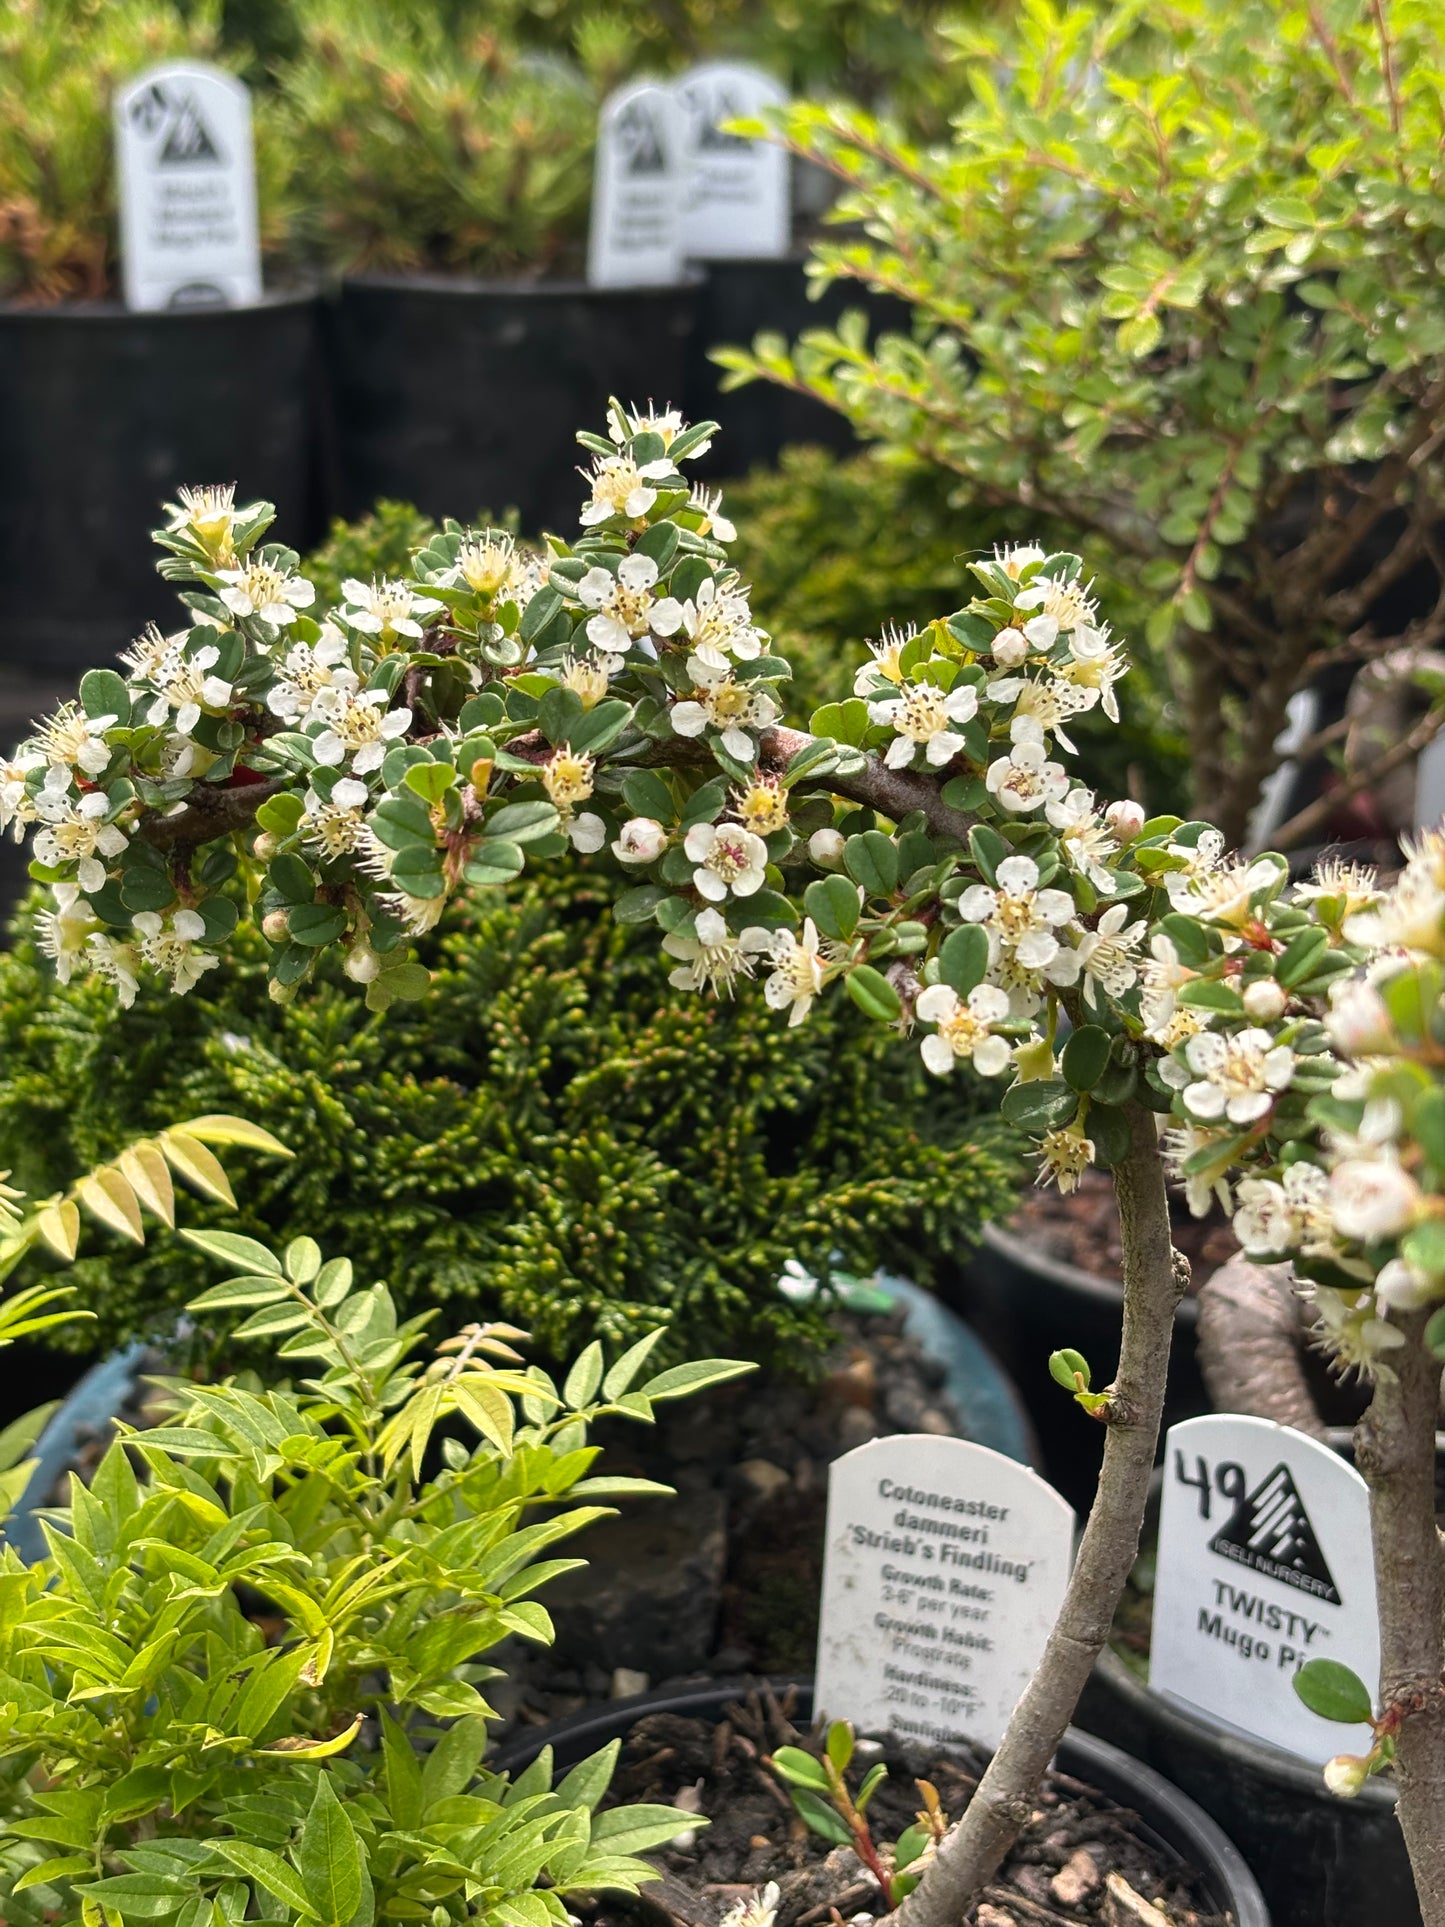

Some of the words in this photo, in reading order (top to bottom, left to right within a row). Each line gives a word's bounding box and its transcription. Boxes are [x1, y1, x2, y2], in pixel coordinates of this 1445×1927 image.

[878, 1478, 1010, 1522] Cotoneaster
[1173, 1448, 1247, 1520] 49
[894, 1508, 989, 1545] dammeri
[881, 1564, 945, 1592] Growth
[948, 1577, 995, 1601] Rate:
[939, 1542, 1035, 1583] Findling'
[1214, 1539, 1254, 1563] ISELI
[1255, 1555, 1335, 1600] NURSERY
[917, 1596, 948, 1613] per
[950, 1602, 991, 1622] year
[874, 1611, 938, 1640] Growth
[941, 1626, 994, 1652] Habit:
[1197, 1607, 1270, 1659] Mugo
[1278, 1642, 1306, 1673] Pi
